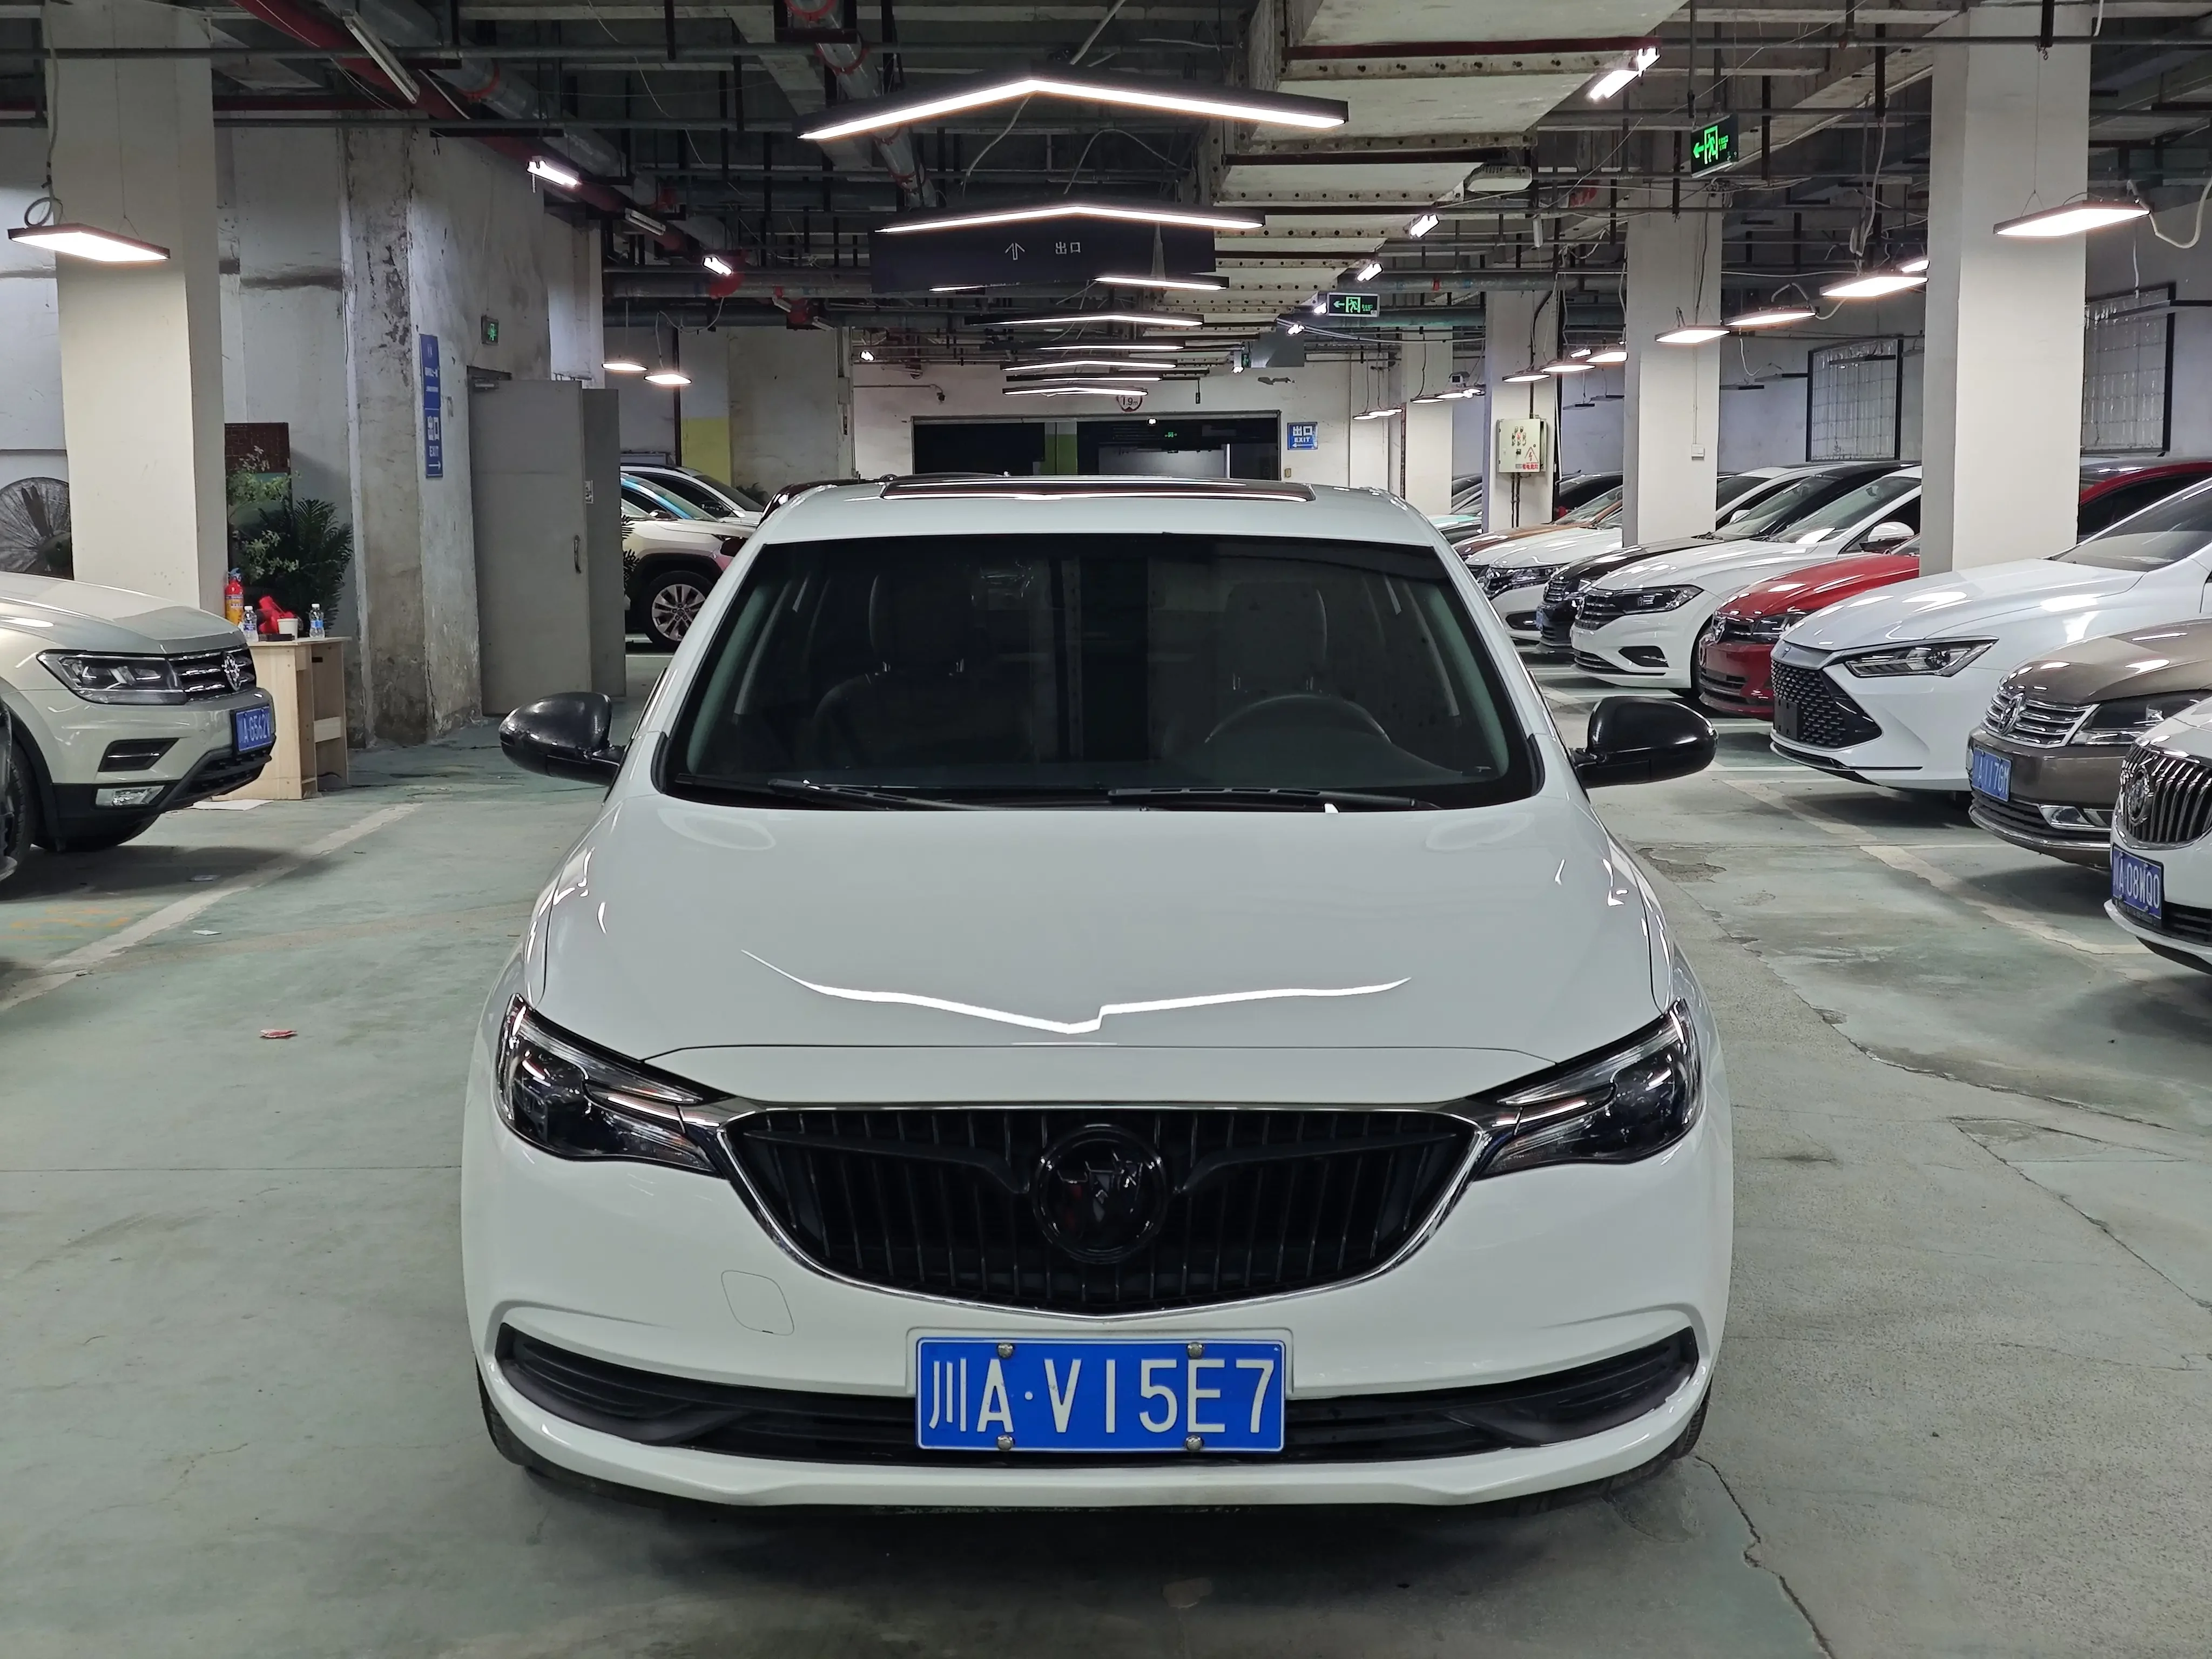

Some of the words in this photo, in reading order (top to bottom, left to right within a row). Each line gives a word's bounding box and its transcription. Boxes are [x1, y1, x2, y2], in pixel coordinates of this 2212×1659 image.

[1055, 241, 1081, 254] 出口
[428, 416, 440, 441] 出口
[1293, 426, 1313, 436] 出口
[929, 1357, 1274, 1433] 川A·V15E7
